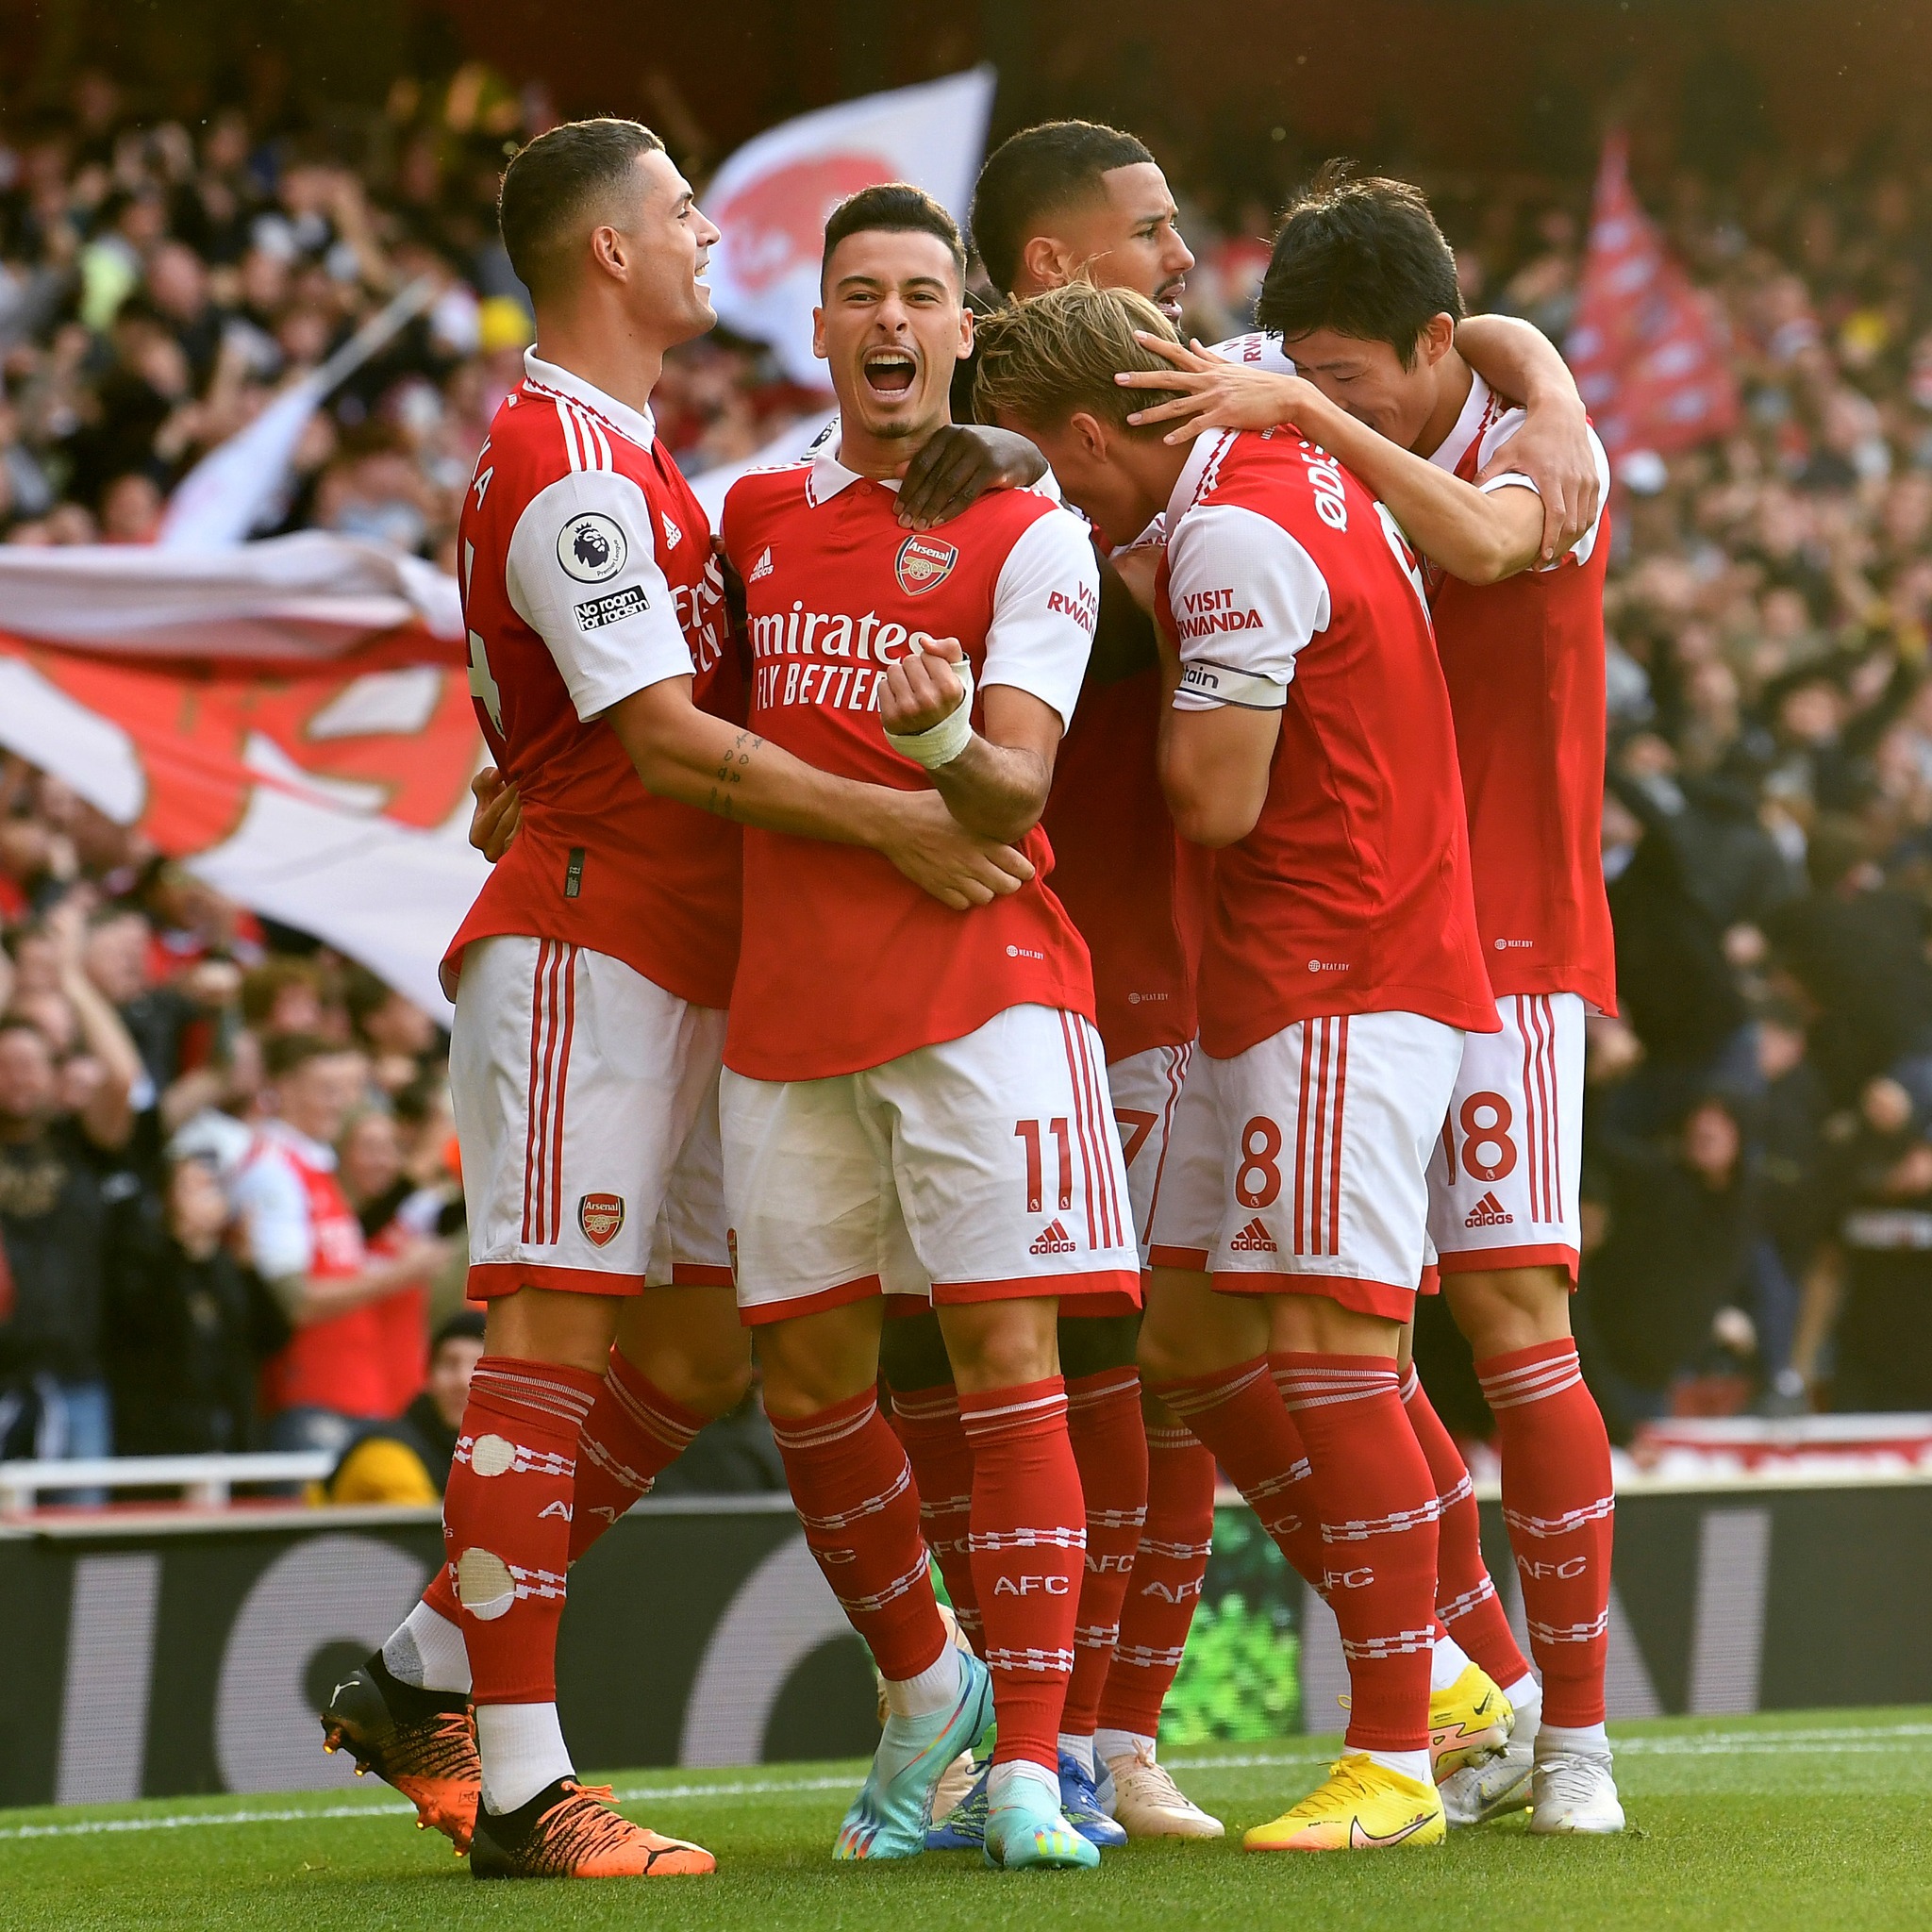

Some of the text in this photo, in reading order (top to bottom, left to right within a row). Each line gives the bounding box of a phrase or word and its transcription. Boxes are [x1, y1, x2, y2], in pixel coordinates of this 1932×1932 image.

[596, 539, 622, 577] Premier League
[908, 541, 950, 561] Arsenal
[574, 591, 639, 621] No room
[1078, 580, 1097, 620] VIS
[1183, 588, 1234, 615] VISIT
[578, 599, 649, 632] for racism
[748, 600, 933, 665] mirates
[757, 664, 781, 711] FLY
[1183, 664, 1219, 690] tain
[1013, 1116, 1074, 1214] 11
[1235, 1114, 1284, 1210] 8
[585, 1201, 620, 1211] Arsenal
[1464, 1212, 1514, 1228] adidas
[1028, 1240, 1077, 1256] adidas
[1230, 1238, 1278, 1253] adidas
[1324, 1567, 1375, 1590] FC
[1516, 1554, 1588, 1580] AFC
[993, 1575, 1070, 1596] AFC
